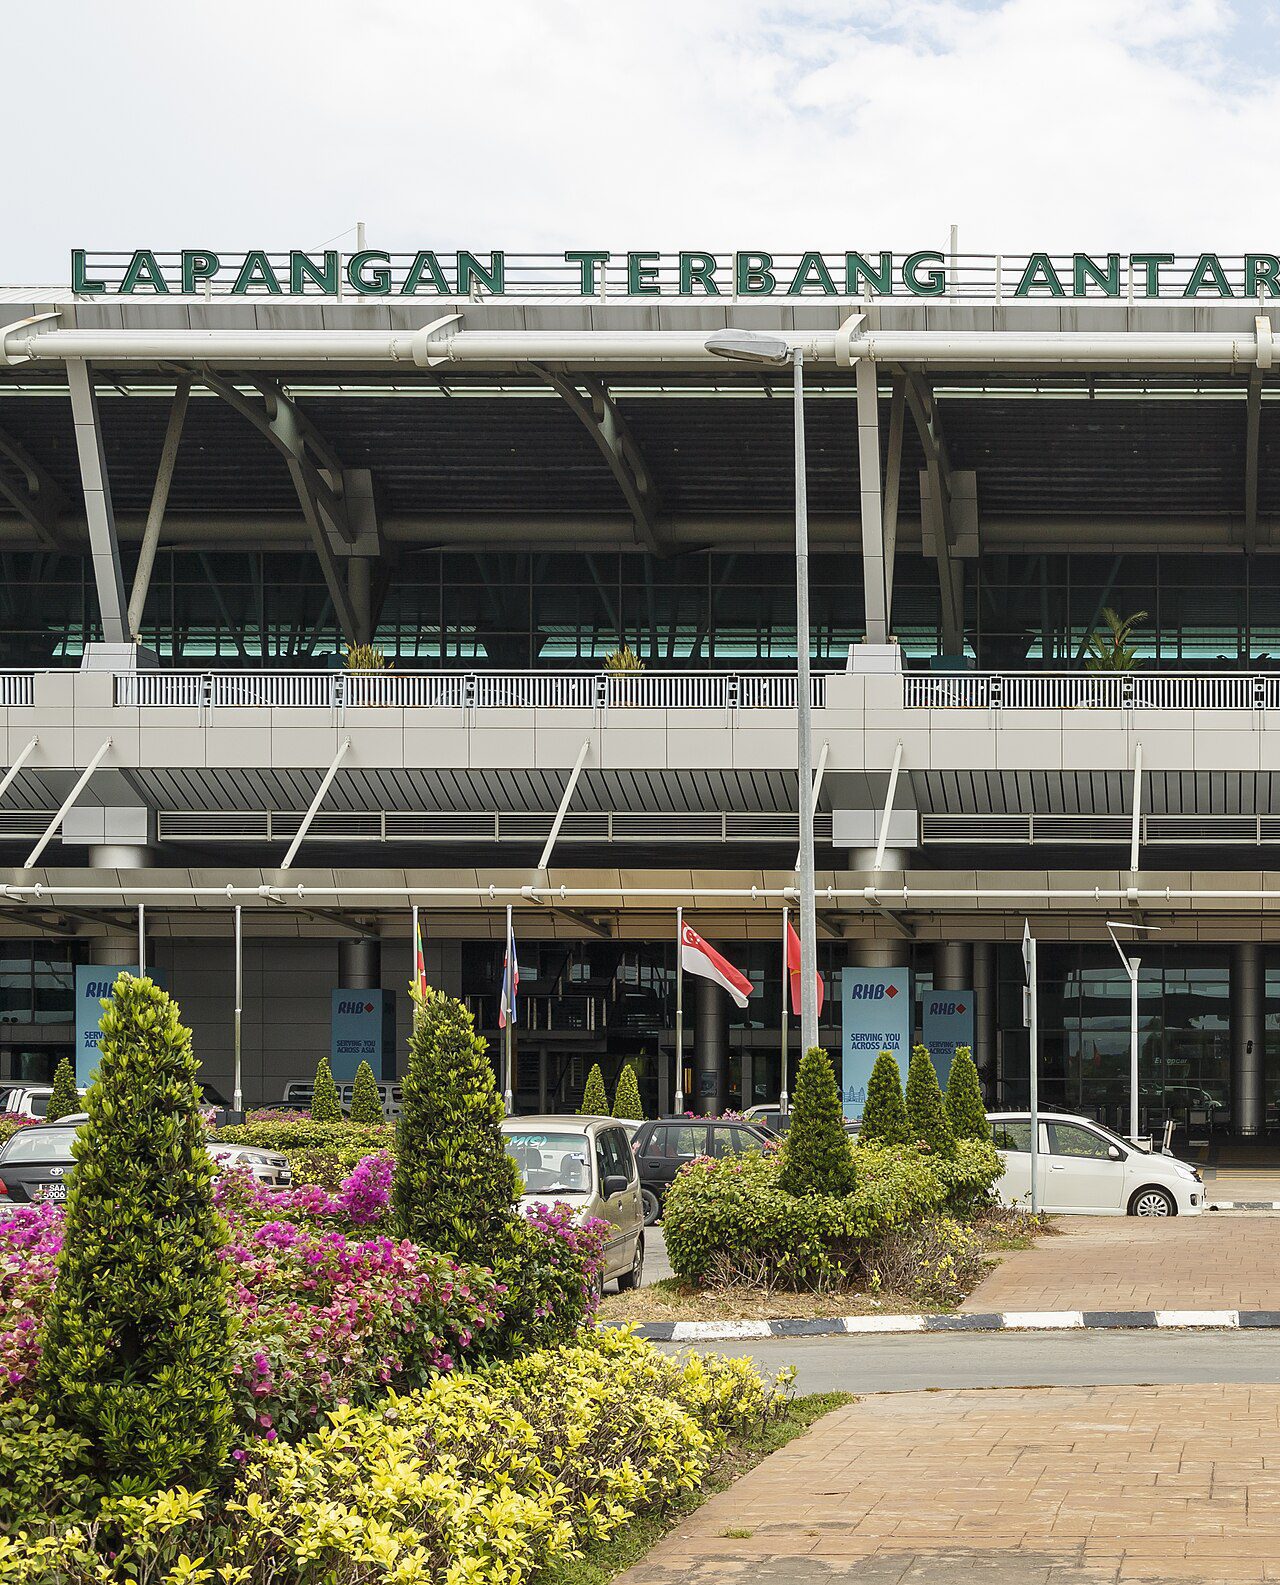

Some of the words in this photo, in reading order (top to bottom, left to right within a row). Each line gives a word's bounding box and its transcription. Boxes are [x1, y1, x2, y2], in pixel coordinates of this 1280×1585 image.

[71, 249, 504, 295] LAPANGAN
[564, 250, 946, 297] TERBANG
[852, 984, 885, 1000] RHB
[338, 1001, 364, 1014] RHB
[930, 1003, 956, 1015] RHB
[851, 1033, 882, 1042] SERVING
[885, 1033, 900, 1042] YOU
[851, 1041, 880, 1050] ACROSS
[882, 1041, 900, 1050] ASIA
[49, 1184, 66, 1192] SAA
